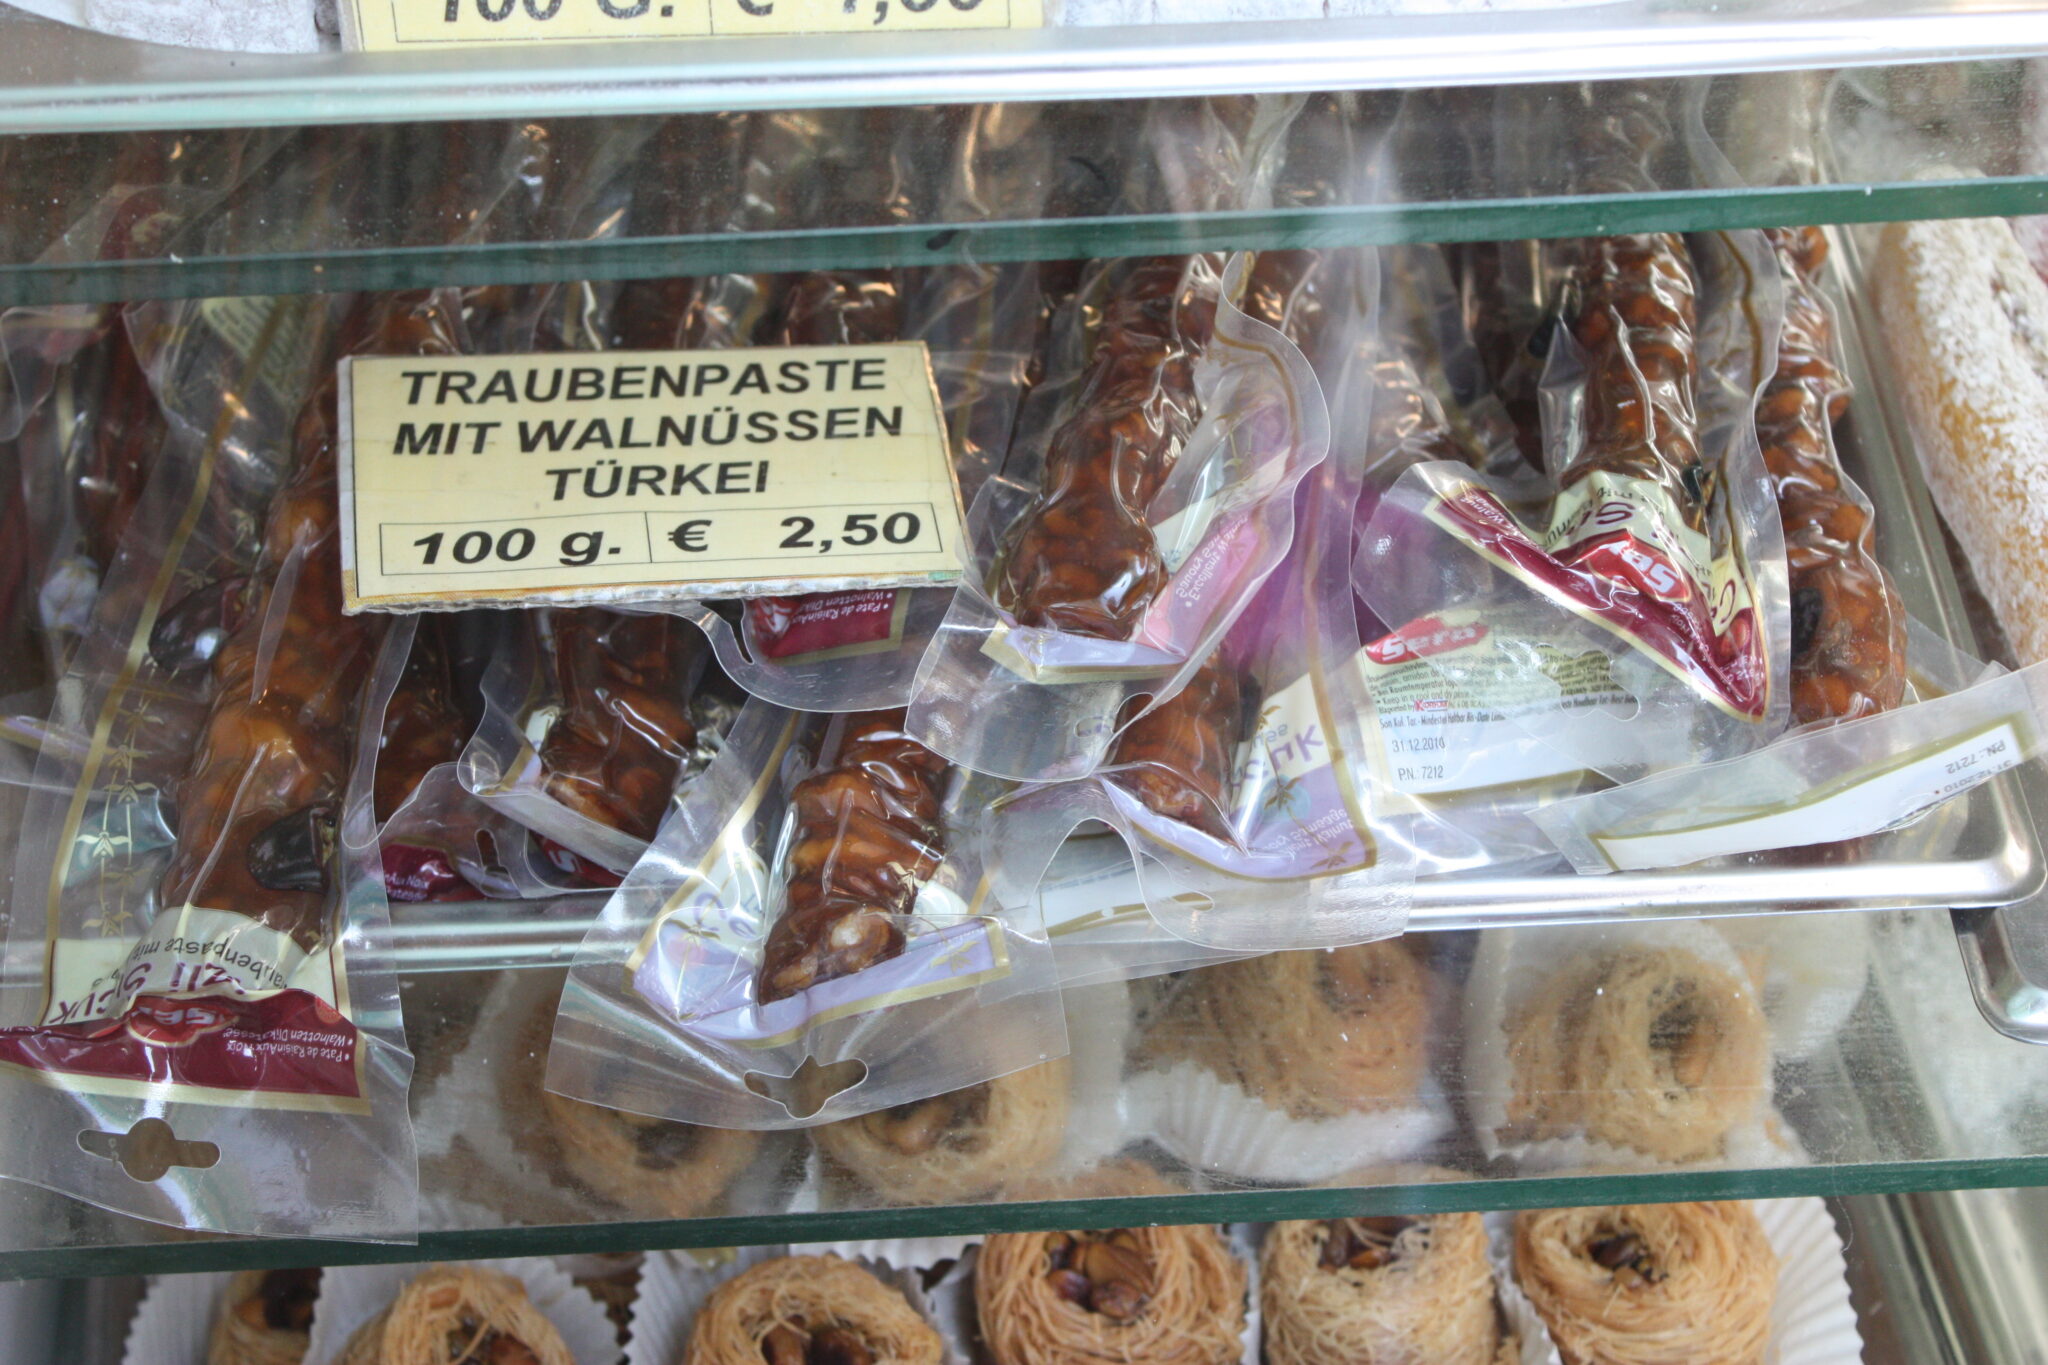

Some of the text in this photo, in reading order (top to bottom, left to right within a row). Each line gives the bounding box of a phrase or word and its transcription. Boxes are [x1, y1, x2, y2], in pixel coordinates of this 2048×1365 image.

[401, 359, 886, 405] TRAUBENPASTE
[392, 406, 903, 455] MIT WALNÜSSEN
[545, 460, 769, 501] TÜRKEI
[413, 512, 921, 566] 100 g. € 2,50
[839, 606, 853, 617] de
[856, 602, 881, 613] Pate
[1422, 765, 1444, 779] 7212
[1945, 754, 1979, 775] 7212
[290, 1028, 346, 1046] Walnotten
[306, 1045, 320, 1059] de
[321, 1047, 343, 1063] Pate
